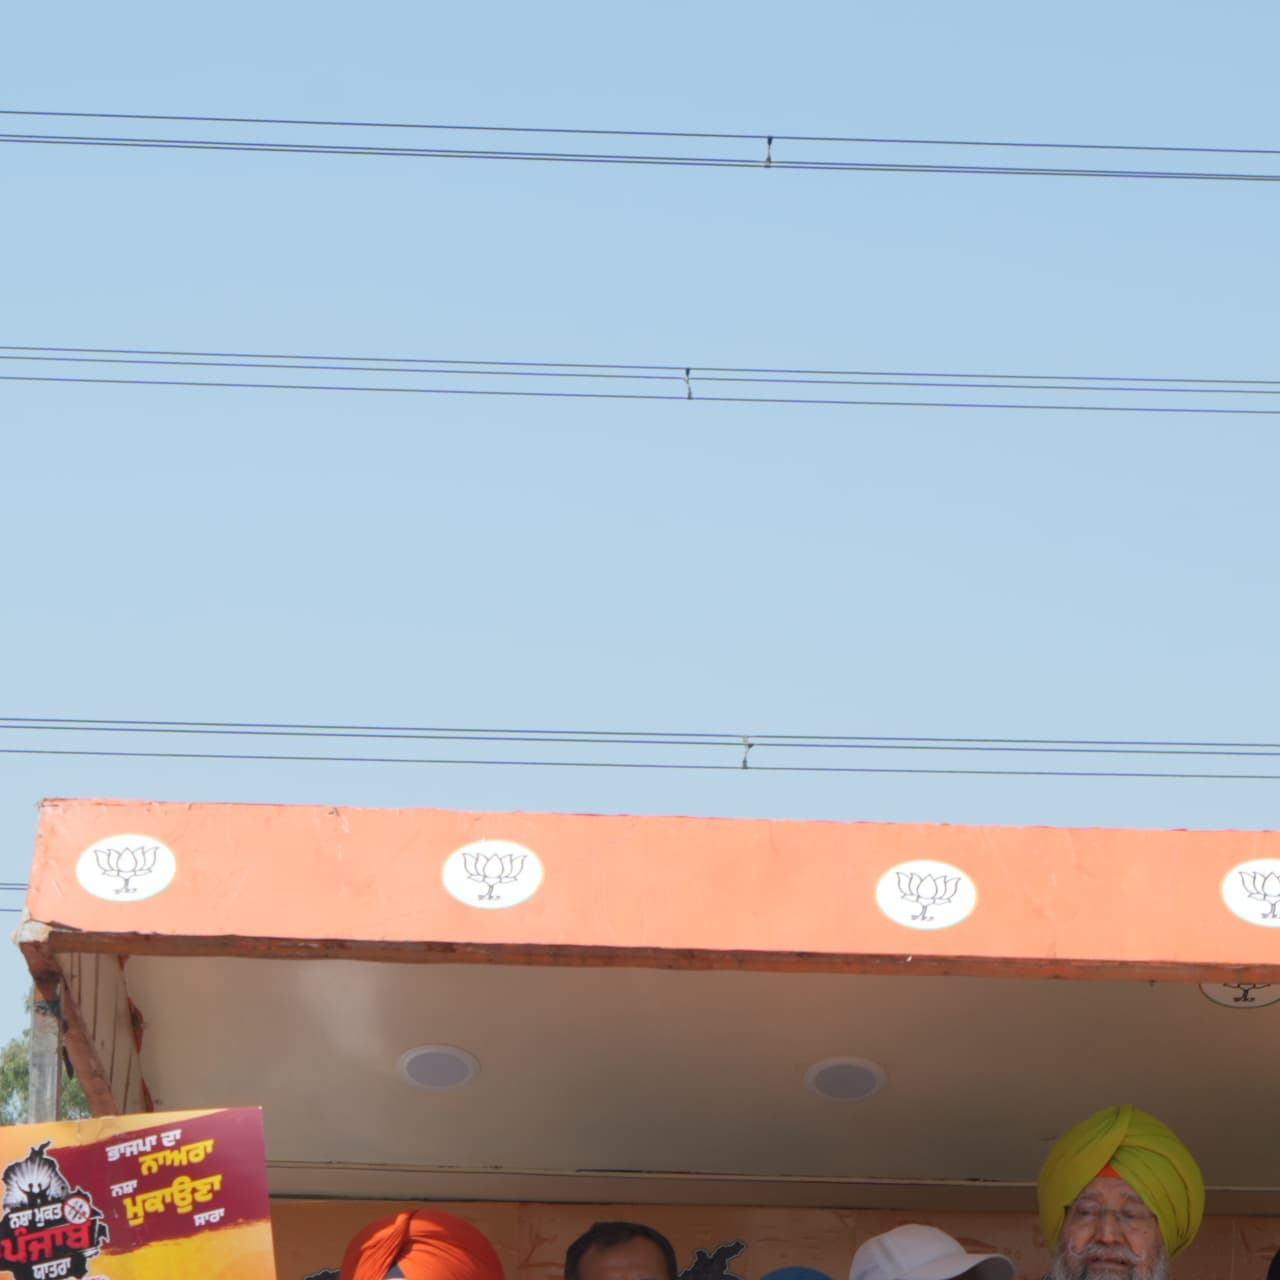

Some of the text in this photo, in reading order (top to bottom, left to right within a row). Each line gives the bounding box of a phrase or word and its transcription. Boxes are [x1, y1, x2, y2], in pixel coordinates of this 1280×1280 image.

[105, 1129, 182, 1162] ਭਾਜਪਾ ਦਾ
[138, 1139, 215, 1176] ਨਾਅਰਾ
[34, 1203, 62, 1227] ਮੁਕਤ
[122, 1174, 222, 1227] ਮੁਕਾਉਣਾ
[193, 1208, 225, 1227] ਸਾਰਾ
[0, 1221, 92, 1264] ਪੰਜਾਬ
